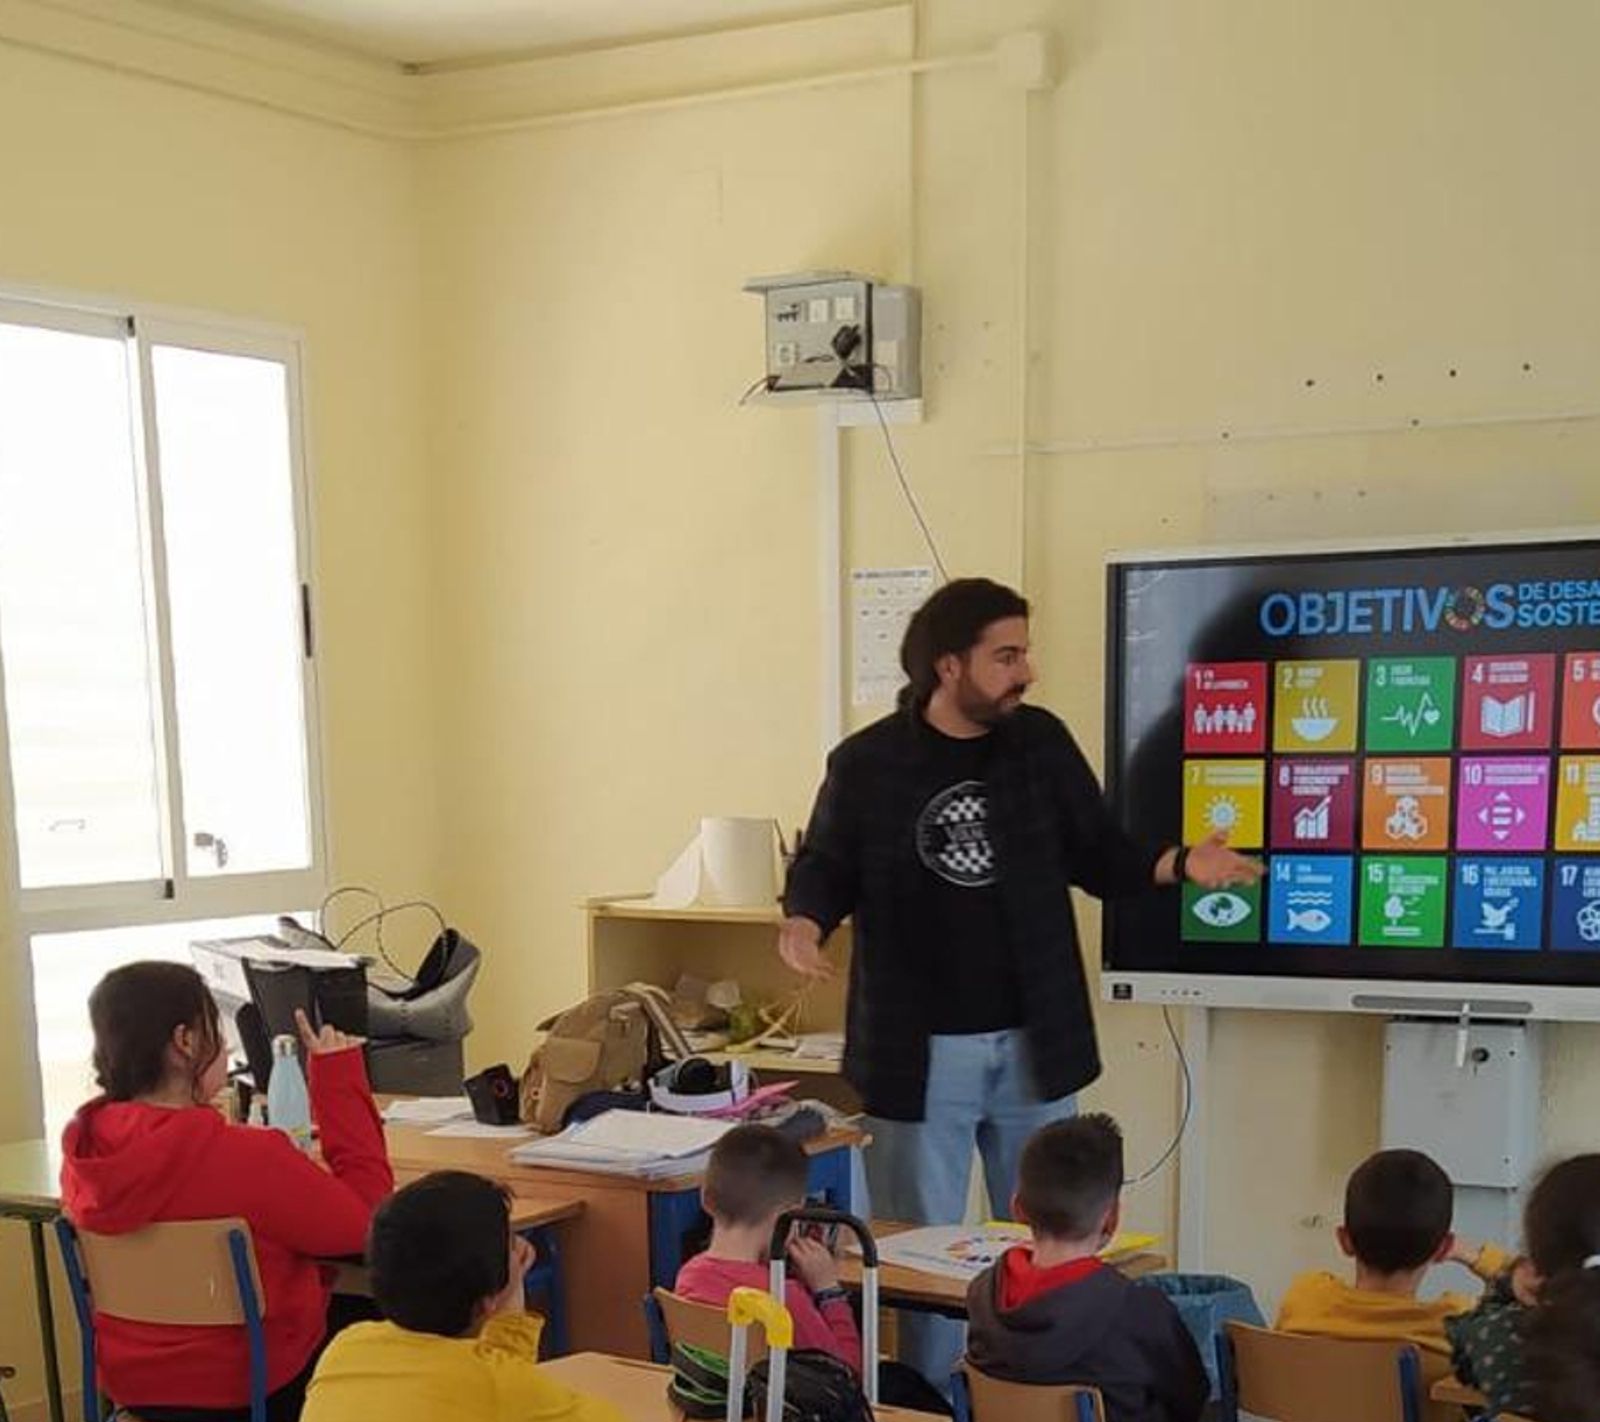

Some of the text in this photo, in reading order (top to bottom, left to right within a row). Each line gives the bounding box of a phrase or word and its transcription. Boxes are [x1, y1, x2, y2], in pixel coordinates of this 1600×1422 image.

[1518, 582, 1546, 601] DE
[1260, 584, 1516, 635] OBJETIVOS
[1517, 601, 1600, 628] SOSTE
[1195, 670, 1202, 690] 1
[1283, 667, 1293, 688] 2
[1376, 665, 1386, 686] 3
[1471, 663, 1483, 684] 4
[1372, 765, 1383, 785] 9
[1464, 765, 1482, 786] 10
[1276, 862, 1291, 882] 14
[1368, 863, 1384, 884] 15
[1462, 864, 1479, 885] 16
[1561, 864, 1578, 887] 17
